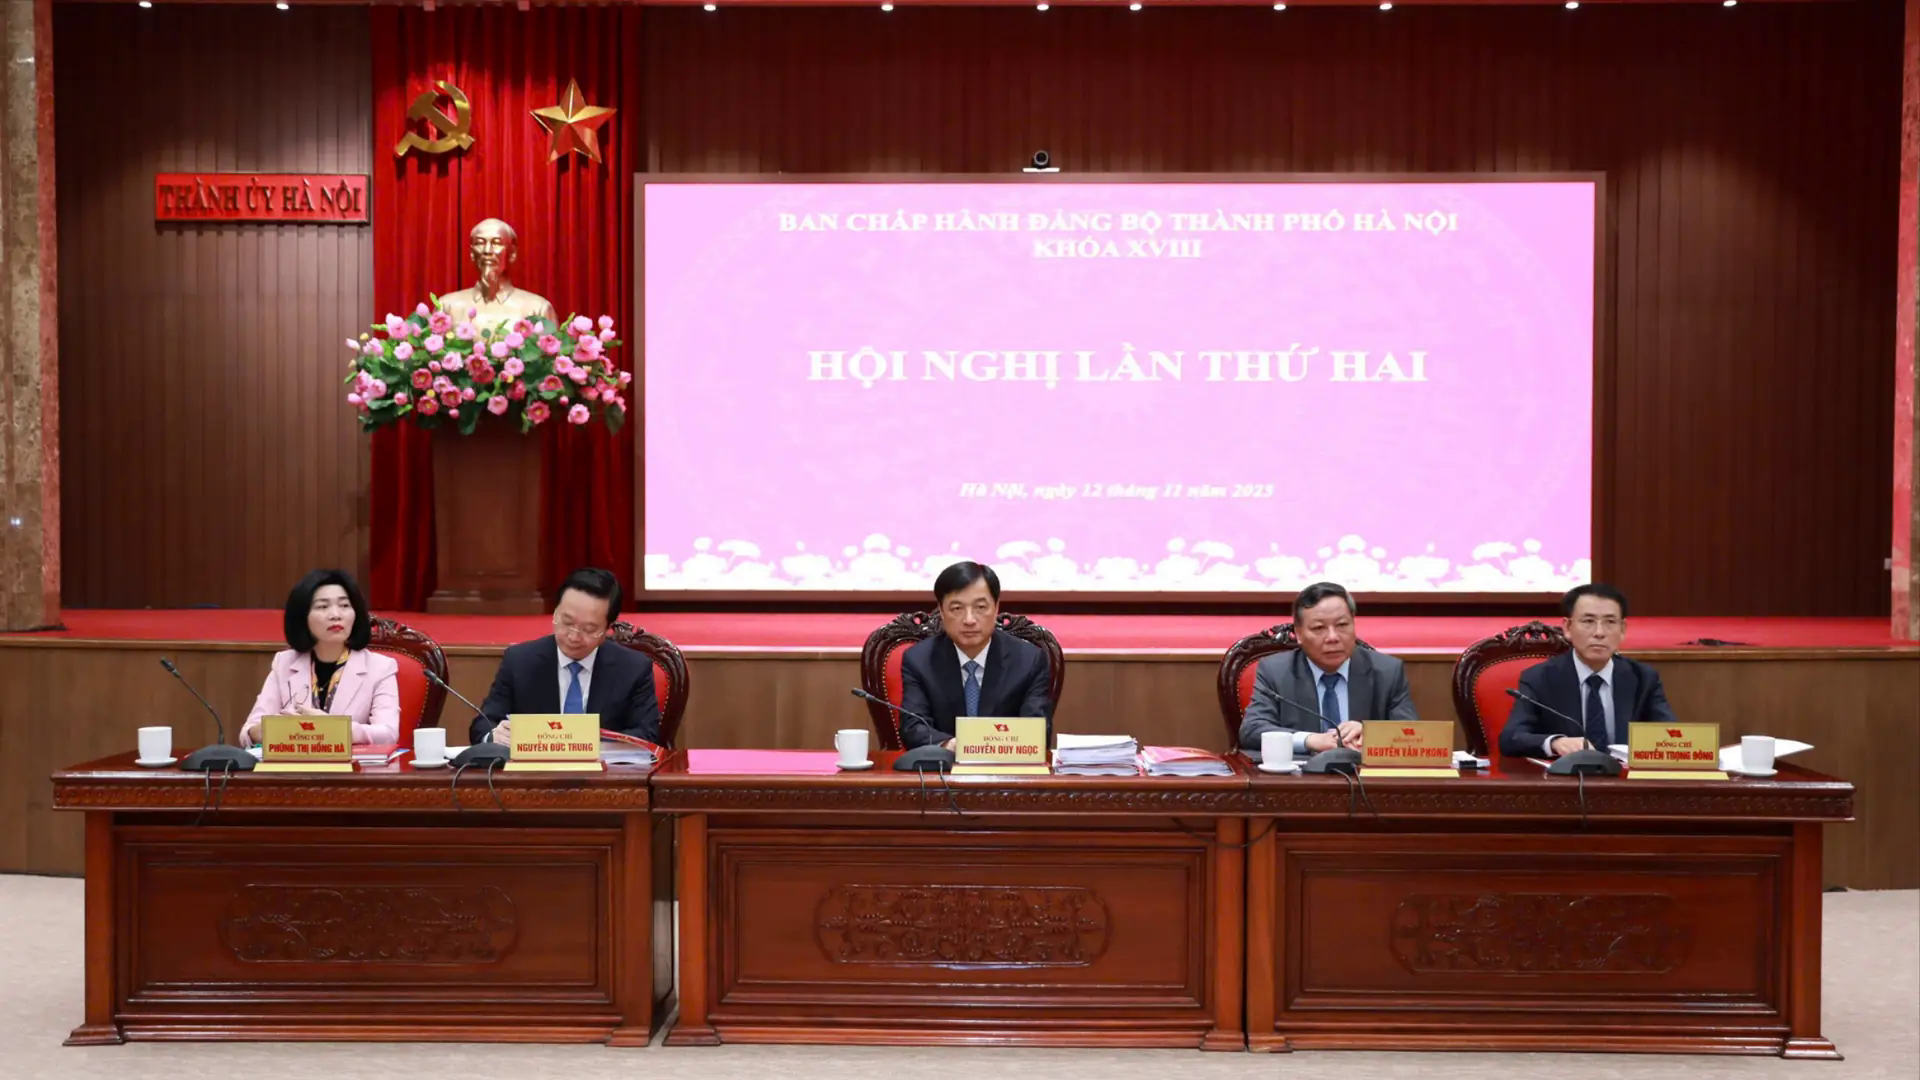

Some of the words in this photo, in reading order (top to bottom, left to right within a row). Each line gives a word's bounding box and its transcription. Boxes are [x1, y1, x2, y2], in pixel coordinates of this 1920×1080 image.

[159, 176, 241, 213] THÀNH
[282, 178, 316, 212] HÀ
[320, 178, 361, 218] NỘI
[778, 212, 838, 231] BAN
[846, 208, 928, 231] CHẤP
[934, 208, 1019, 231] HÀNH
[1027, 208, 1112, 231] ĐẢNG
[1119, 209, 1162, 235] BỘ
[1168, 208, 1275, 231] THÀNH
[1283, 208, 1345, 231] PHỐ
[1353, 208, 1396, 231] HÀ
[1403, 209, 1459, 236] NỘI
[1033, 235, 1120, 258] KHÓA
[1126, 238, 1202, 258] XVIII
[806, 346, 908, 389] HỘI
[920, 350, 1062, 390] NGHỊ
[1073, 341, 1186, 382] LẦN
[1197, 342, 1319, 382] THỨ
[1329, 351, 1428, 382] HAI
[959, 482, 987, 497] Hà
[989, 482, 1028, 499] Nội,
[1033, 482, 1077, 500] ngày
[1082, 483, 1102, 497] 12
[1107, 482, 1158, 500] tháng
[1162, 483, 1182, 497] 11
[1187, 483, 1226, 497] năm
[1232, 483, 1274, 498] 2025
[550, 741, 566, 752] ĐỨC
[568, 743, 593, 752] TRUNG
[998, 745, 1014, 754] DUY
[1016, 745, 1038, 756] NGỌC
[1402, 745, 1418, 757] VĂN
[1420, 747, 1449, 758] PHONG
